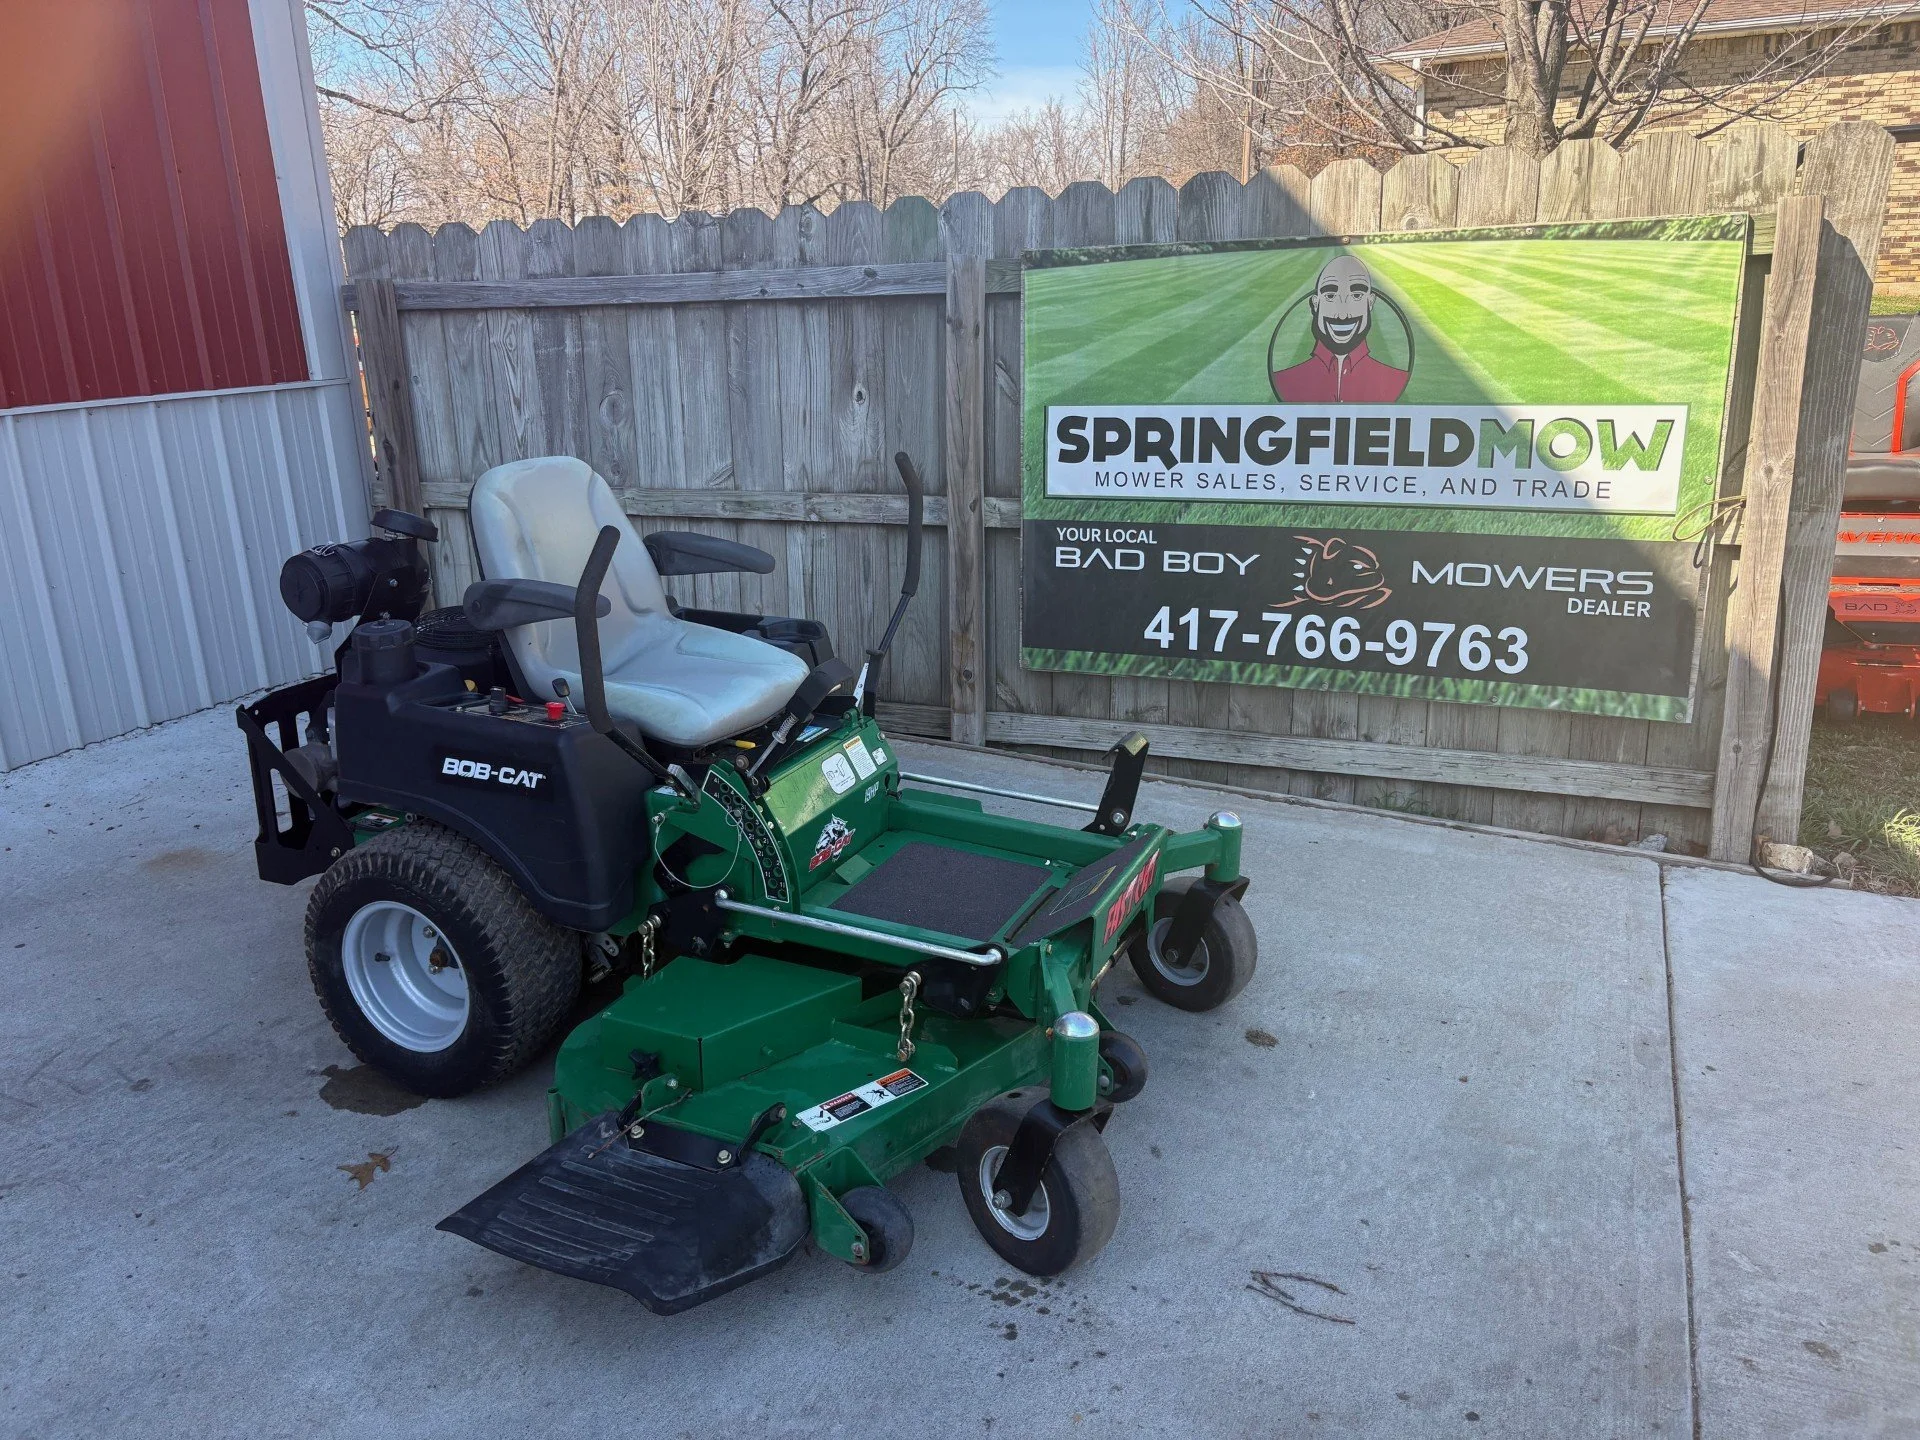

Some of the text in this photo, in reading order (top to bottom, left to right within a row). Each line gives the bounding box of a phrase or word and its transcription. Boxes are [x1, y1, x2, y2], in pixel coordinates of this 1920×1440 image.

[1056, 415, 1675, 472] SPRINGFIELDMOW
[1095, 471, 1612, 499] MOWER SALES, SERVICE, AND TRADE
[1056, 527, 1158, 545] YOUR LOCAL
[1055, 546, 1654, 595] BAD BOY MOWERS
[1566, 597, 1651, 618] DEALER
[1844, 602, 1888, 611] BAD
[1143, 605, 1529, 675] 417-766-9763
[441, 757, 543, 789] BOB-CAT
